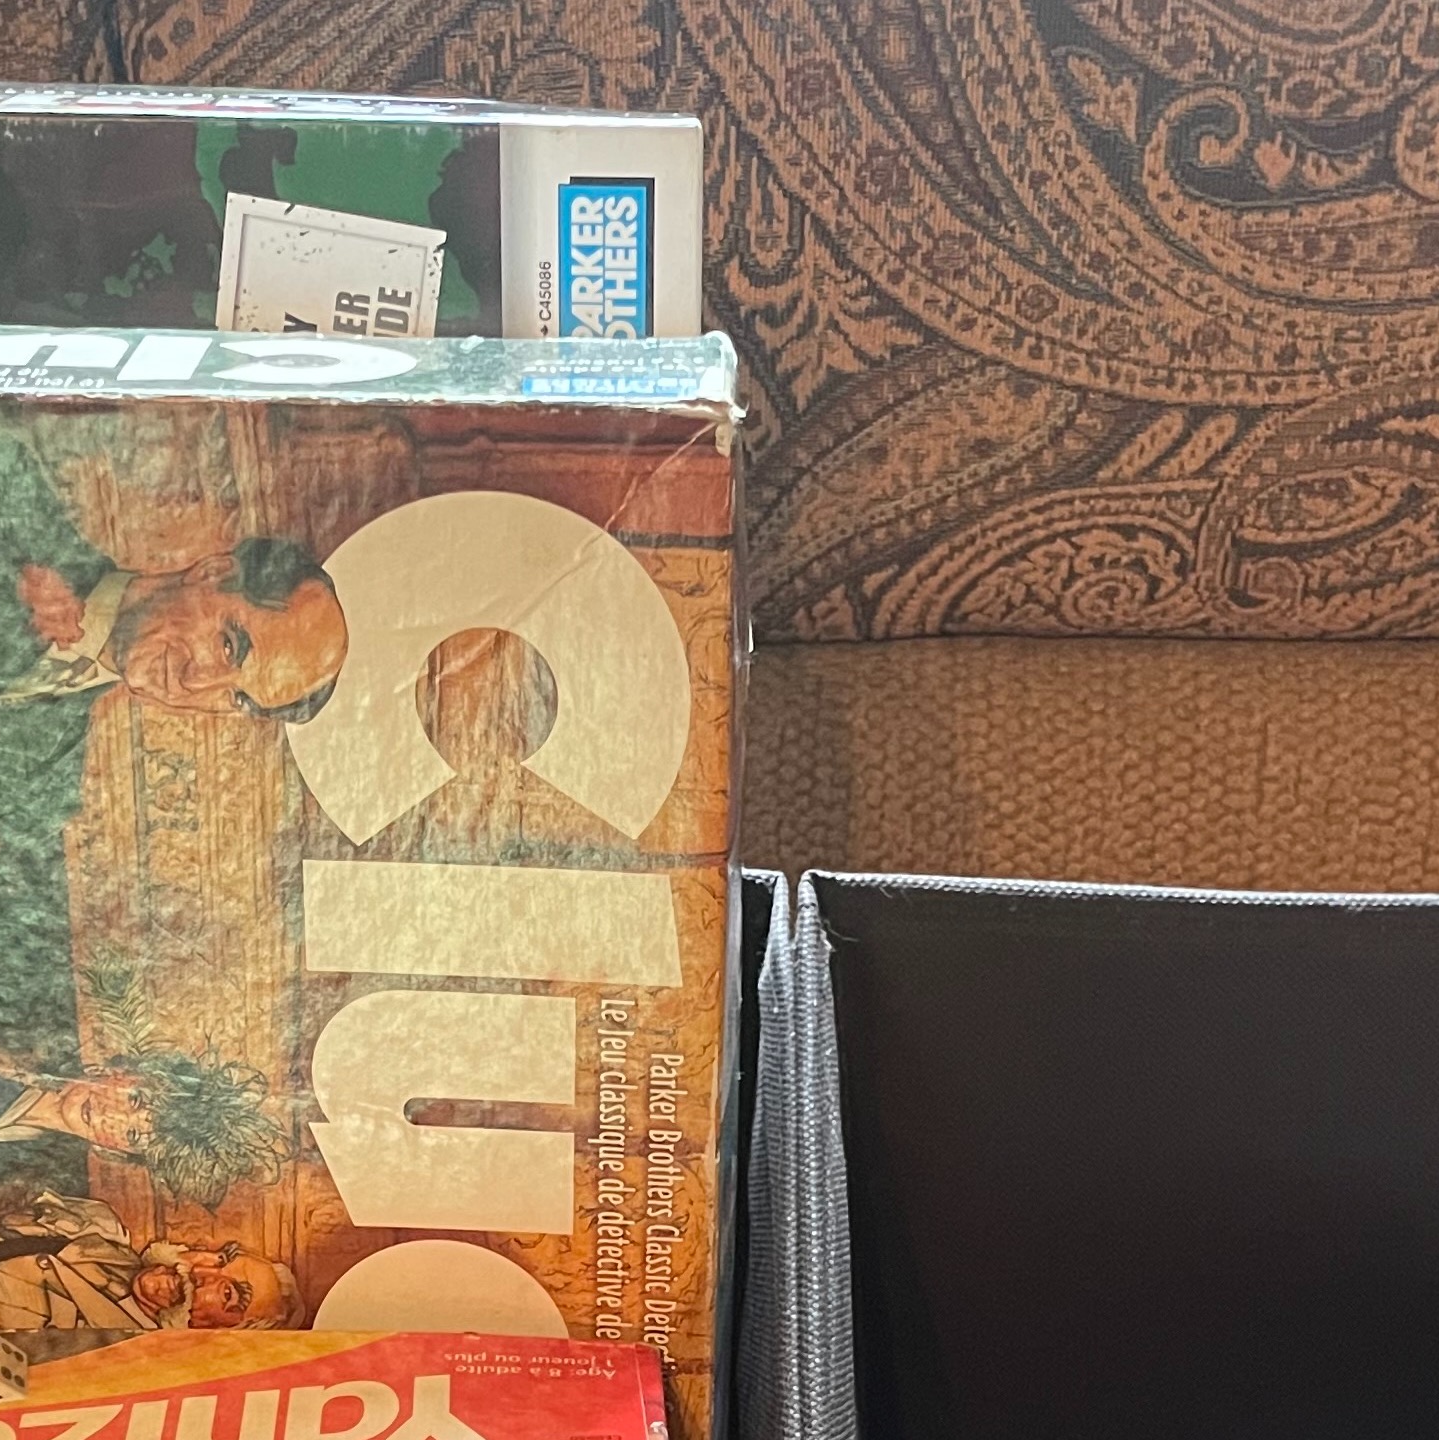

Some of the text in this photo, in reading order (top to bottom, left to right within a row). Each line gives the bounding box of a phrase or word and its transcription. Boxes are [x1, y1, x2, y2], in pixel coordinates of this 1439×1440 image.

[538, 261, 552, 322] C45086
[587, 1071, 639, 1306] classique de détective
[643, 1053, 688, 1293] Parker Brothers Classic
